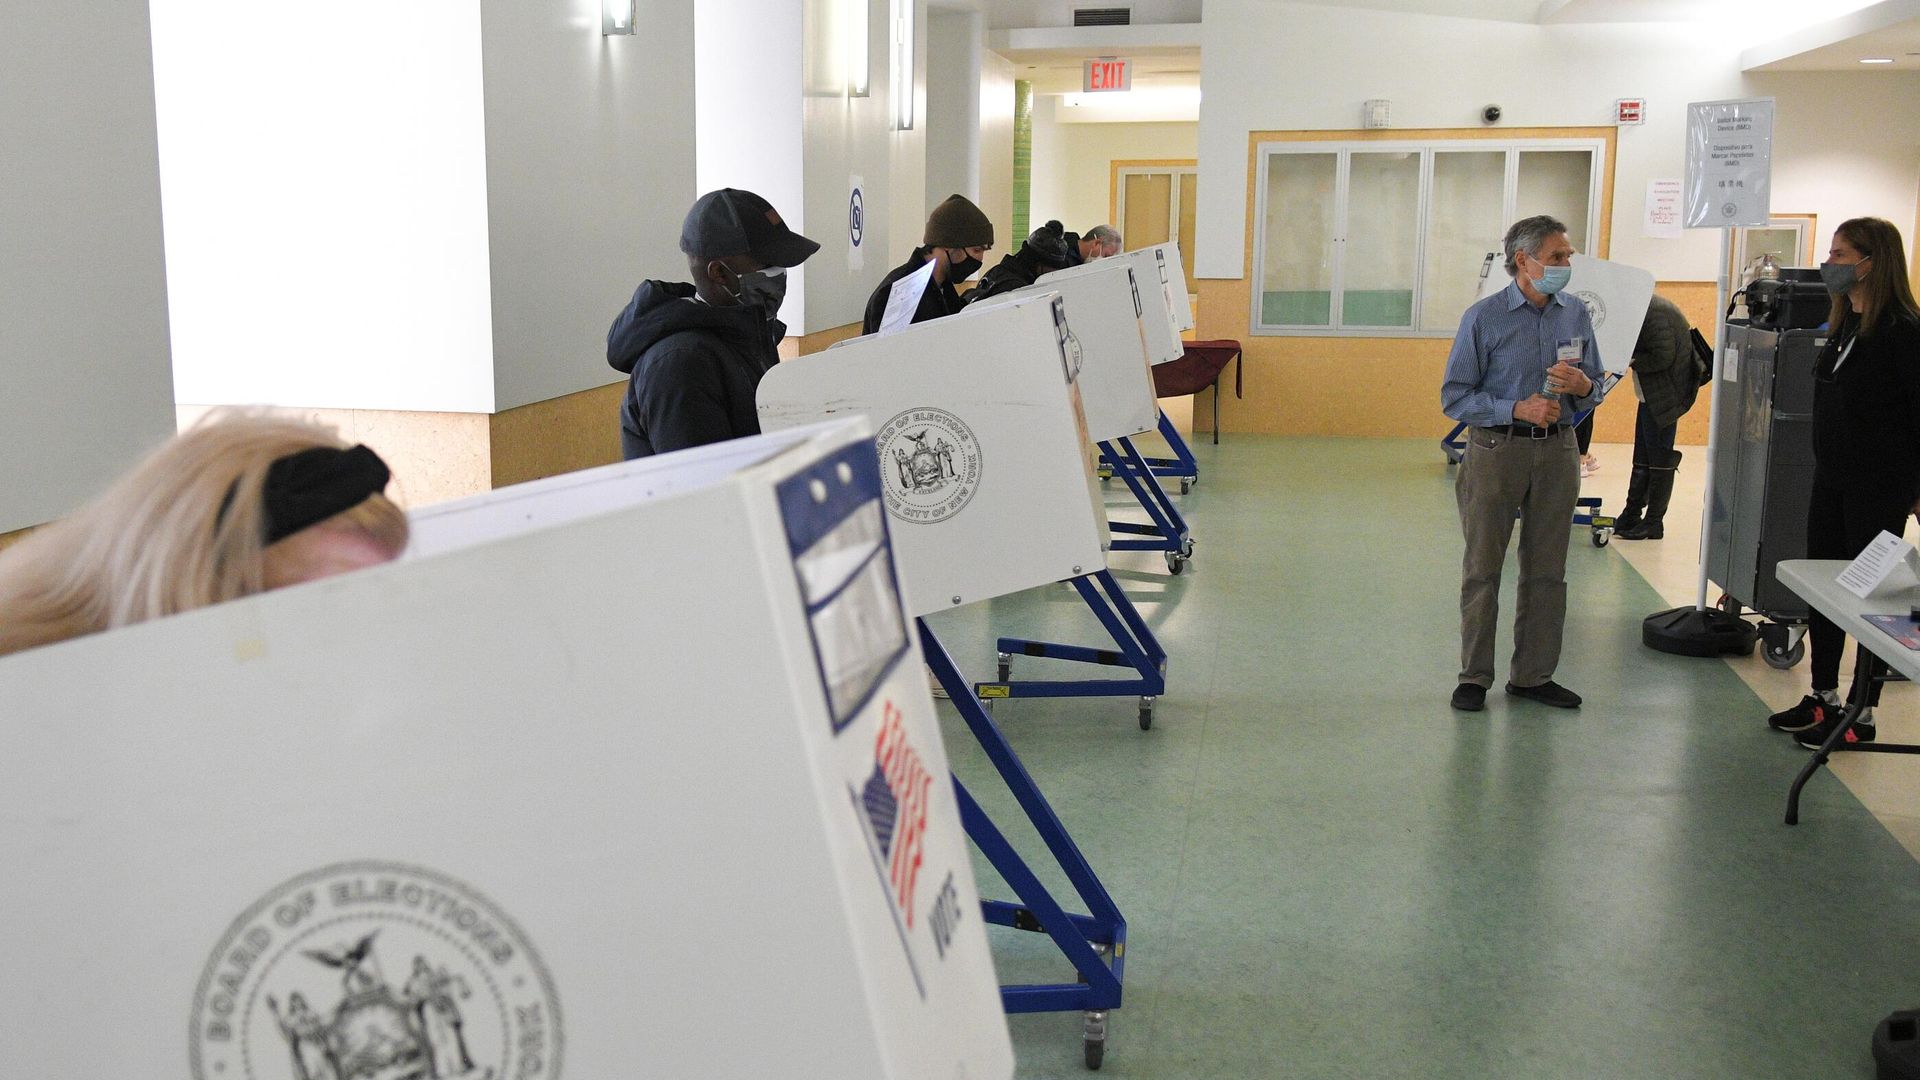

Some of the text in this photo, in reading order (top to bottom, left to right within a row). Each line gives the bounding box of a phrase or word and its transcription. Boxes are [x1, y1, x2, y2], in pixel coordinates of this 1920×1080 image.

[1091, 63, 1125, 89] EXIT
[896, 416, 909, 428] OF
[913, 412, 969, 442] ELECTIONS
[885, 454, 977, 519] THE CITY OF NEW YORK
[207, 879, 515, 1041] BOARD OF ELECTIONS
[515, 1001, 543, 1080] ORK
